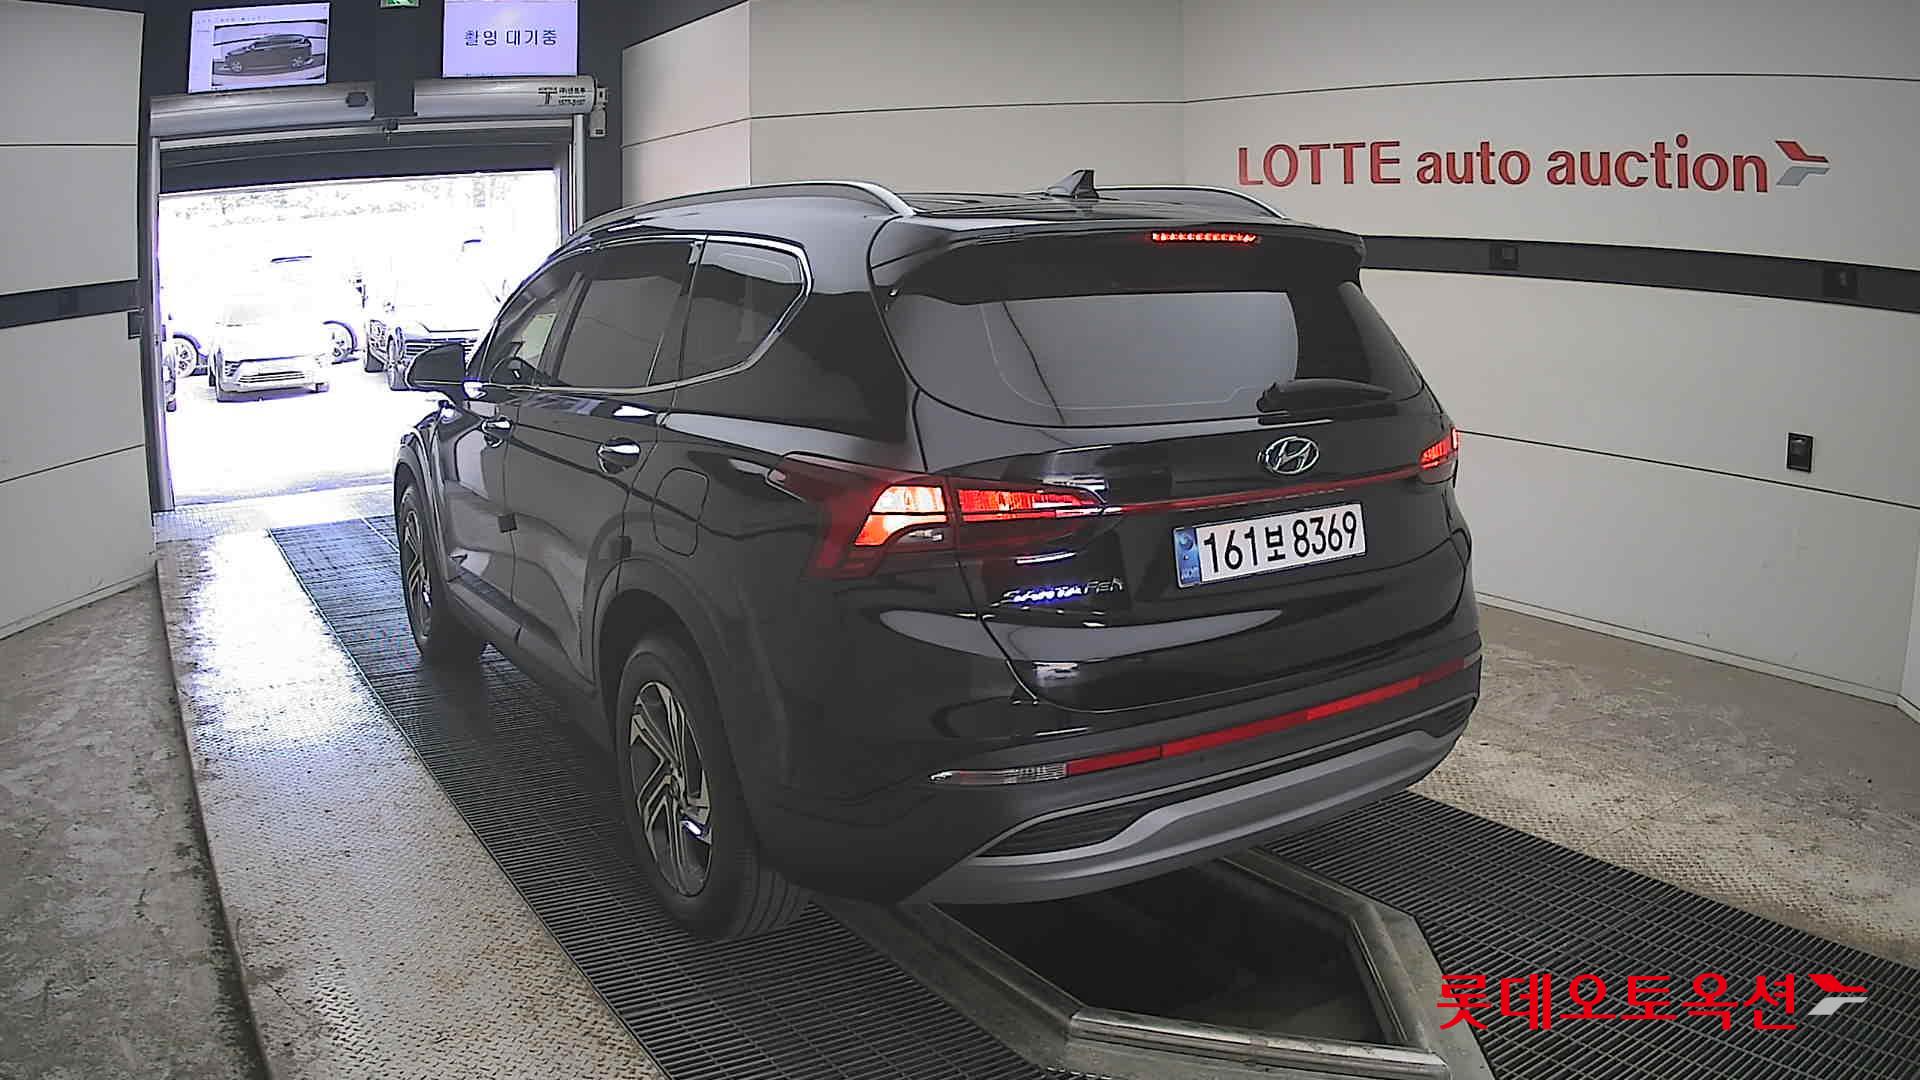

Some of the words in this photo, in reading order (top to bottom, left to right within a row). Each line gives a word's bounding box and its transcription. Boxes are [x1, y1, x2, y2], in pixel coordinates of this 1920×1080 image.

[506, 29, 557, 46] 대기중
[1237, 142, 1398, 187] LOTTE
[1417, 142, 1531, 185] auto
[1546, 136, 1769, 192] auction
